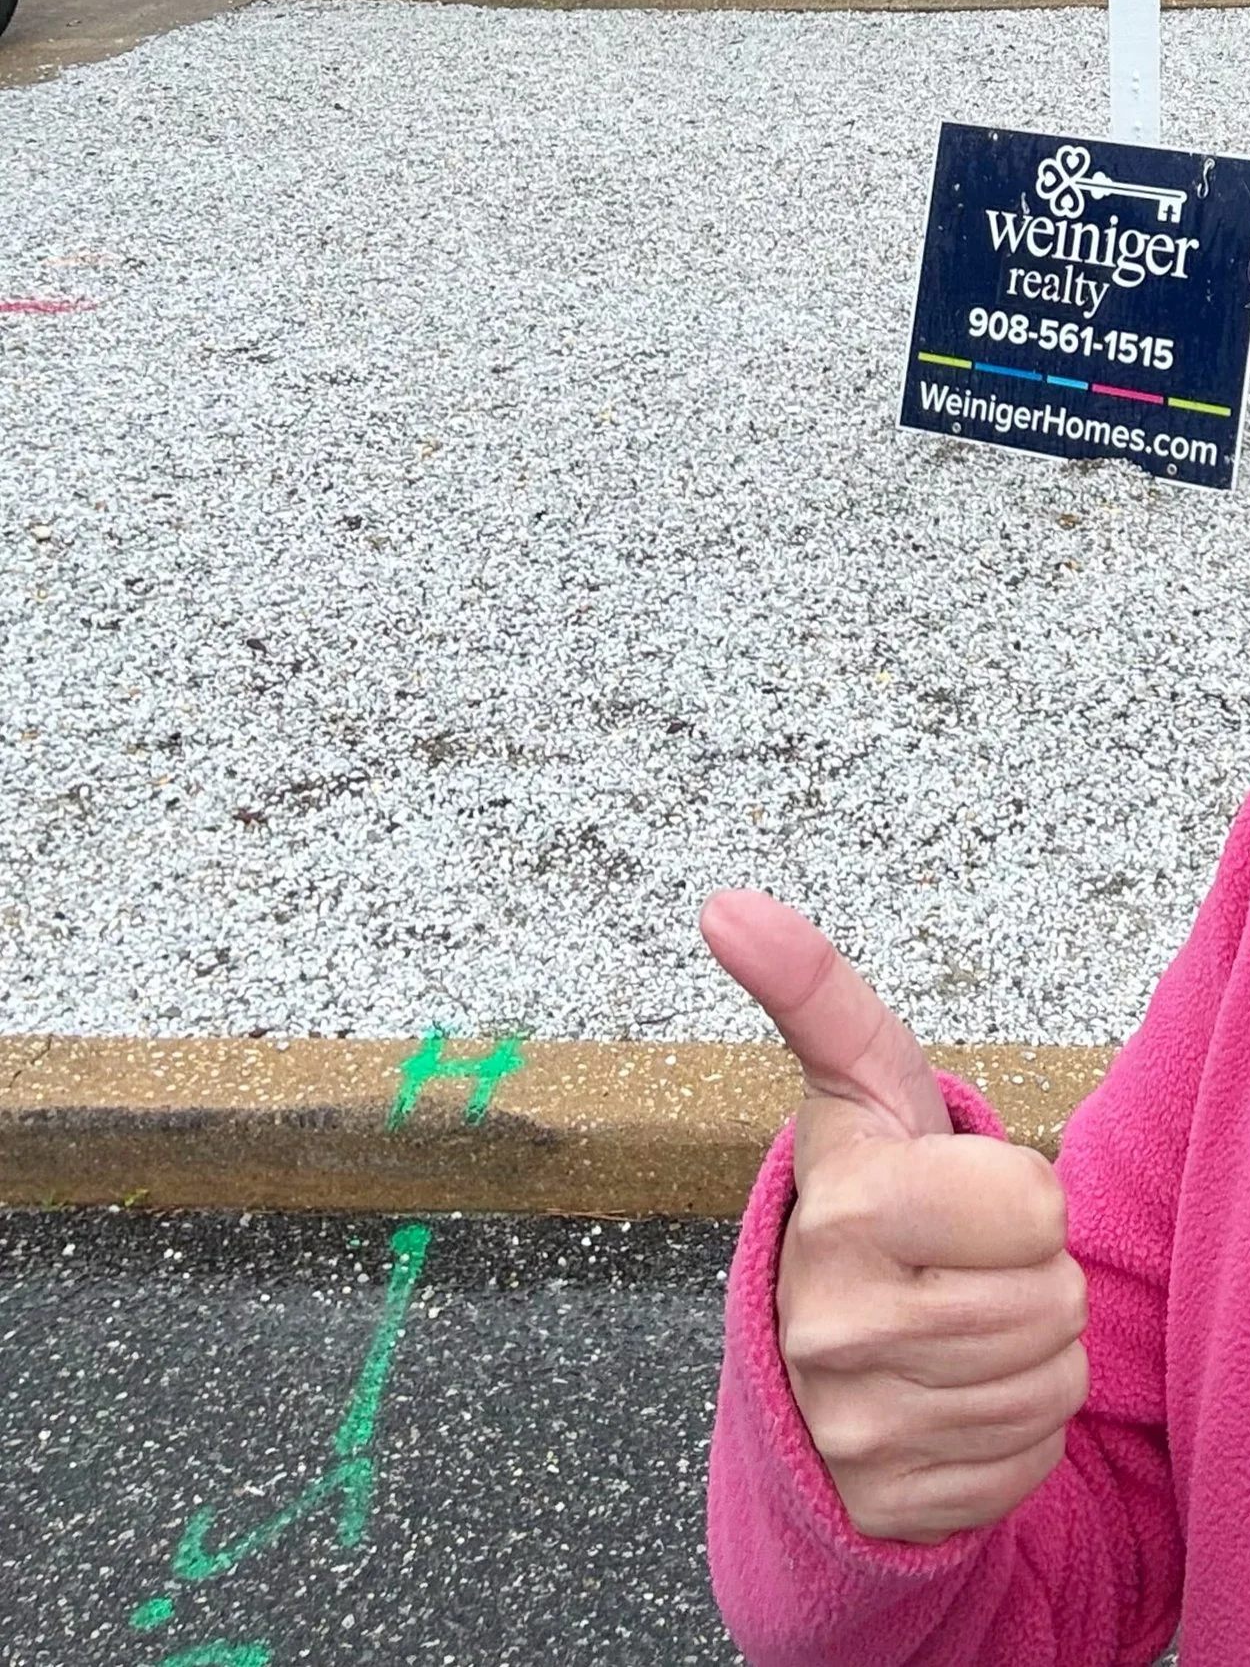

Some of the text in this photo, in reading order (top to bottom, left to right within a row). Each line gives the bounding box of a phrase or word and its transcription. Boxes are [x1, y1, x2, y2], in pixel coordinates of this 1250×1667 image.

[1006, 266, 1109, 319] realty
[968, 308, 1174, 369] 908-561-1515
[920, 381, 1218, 466] WeinigerHomes.com
